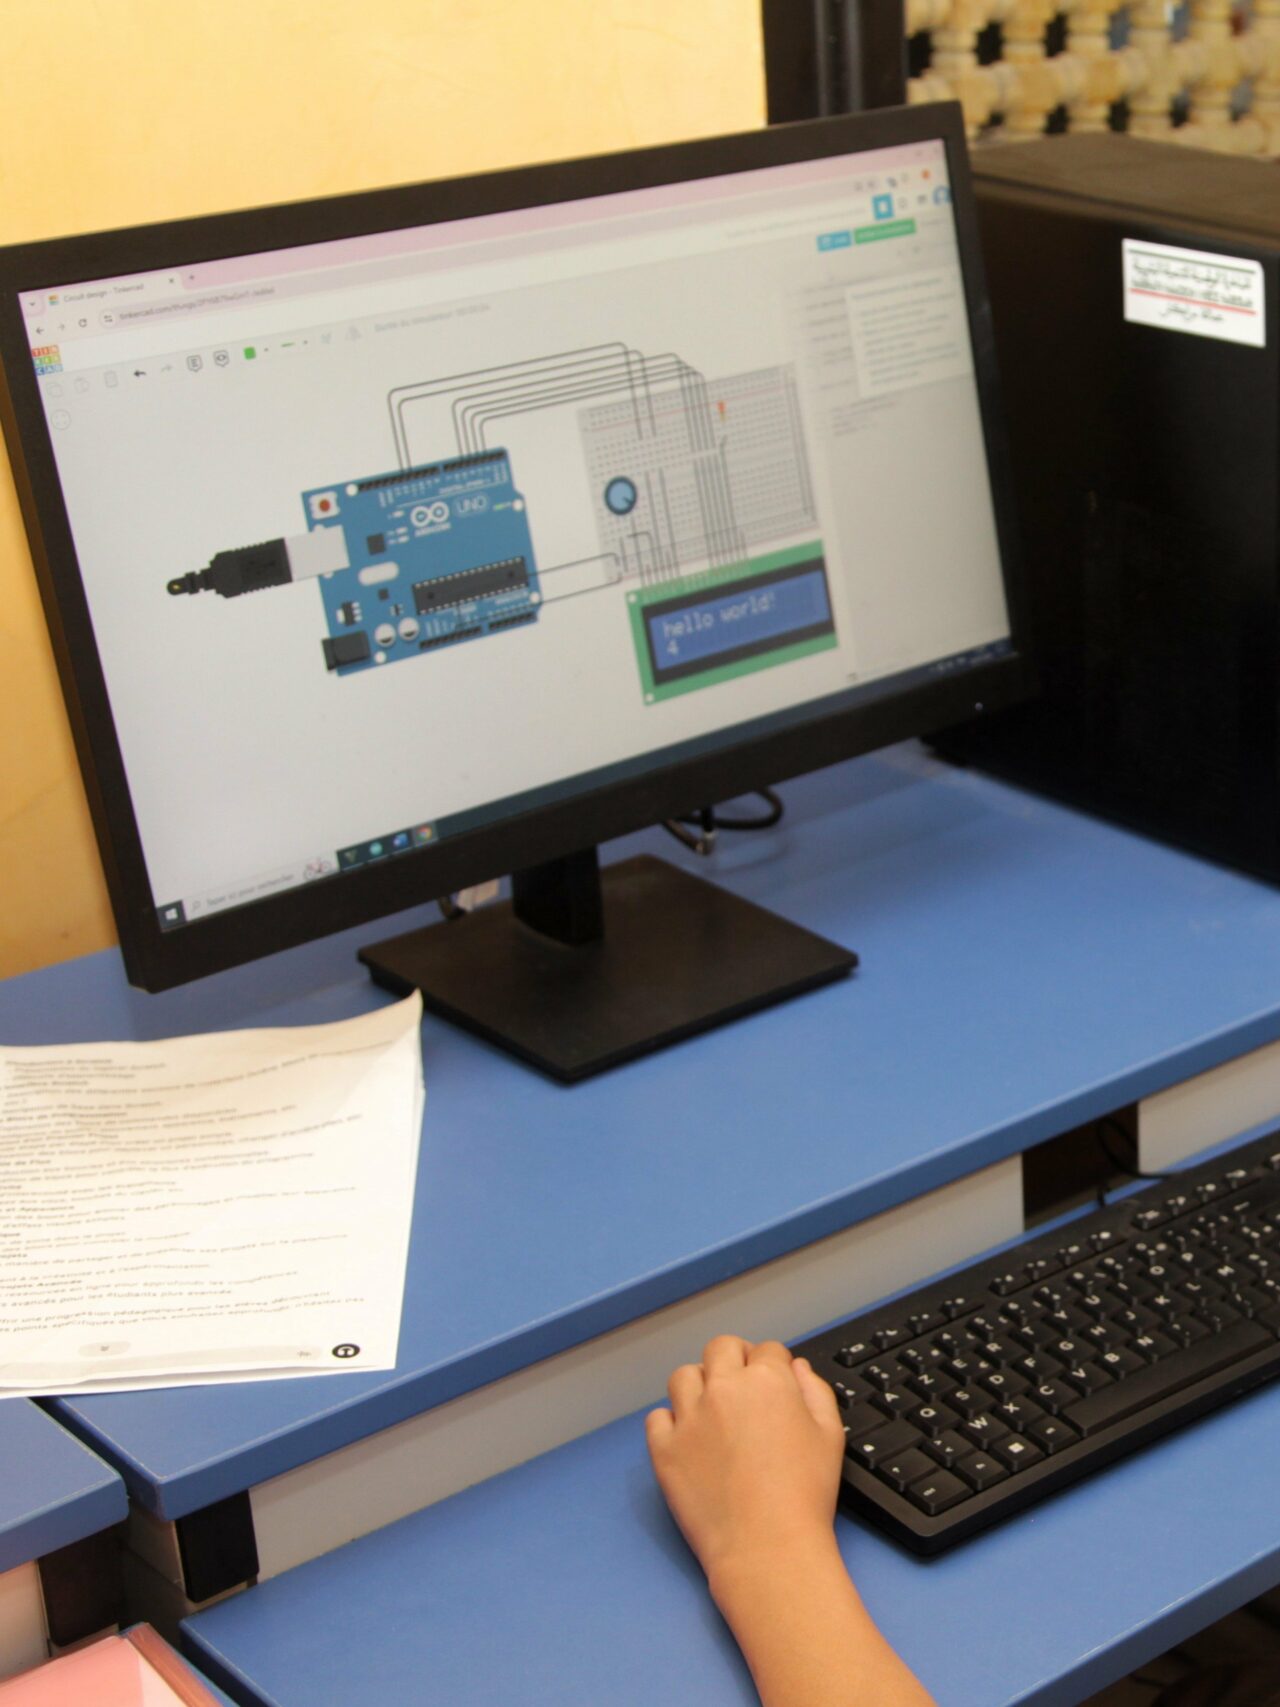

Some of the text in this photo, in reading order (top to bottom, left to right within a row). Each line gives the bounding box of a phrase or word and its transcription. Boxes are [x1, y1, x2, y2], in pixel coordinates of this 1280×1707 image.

[456, 495, 488, 514] UNO
[663, 609, 715, 639] hello
[666, 641, 680, 656] 4
[1150, 1266, 1164, 1275] O
[1086, 1295, 1100, 1304] U
[1155, 1296, 1169, 1304] K
[1055, 1311, 1067, 1319] Y
[1091, 1326, 1105, 1335] H
[1059, 1341, 1074, 1350] G
[1138, 1337, 1153, 1346] N
[987, 1343, 1001, 1352] R
[1105, 1353, 1120, 1362] B
[952, 1359, 967, 1368] E
[1024, 1358, 1035, 1367] F
[1072, 1368, 1085, 1377] V
[919, 1374, 933, 1384] Z
[989, 1375, 1004, 1384] D
[1040, 1386, 1054, 1395] C
[885, 1393, 898, 1402] A
[956, 1391, 969, 1400] S
[1004, 1403, 1019, 1413] X
[969, 1417, 987, 1429] W
